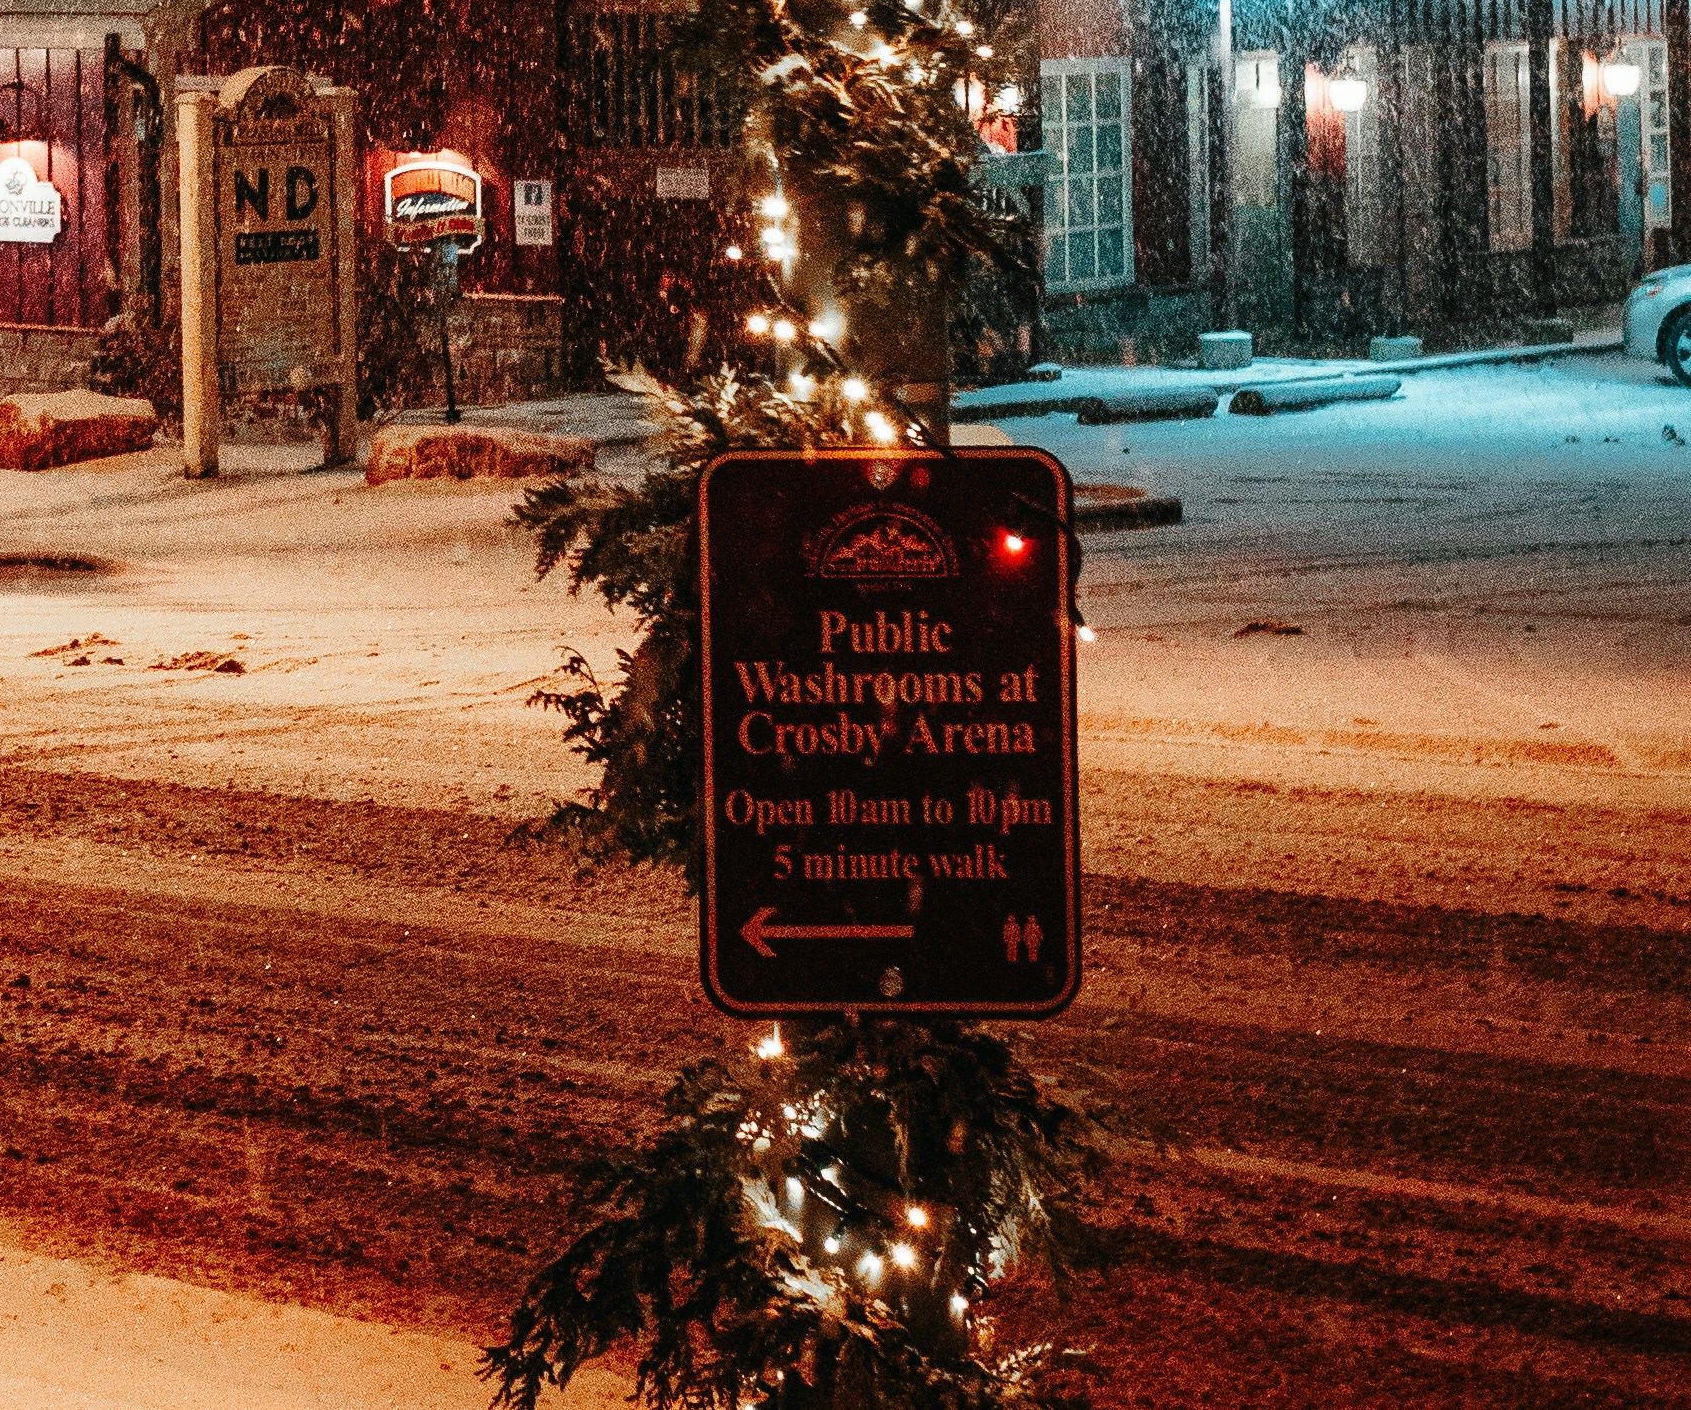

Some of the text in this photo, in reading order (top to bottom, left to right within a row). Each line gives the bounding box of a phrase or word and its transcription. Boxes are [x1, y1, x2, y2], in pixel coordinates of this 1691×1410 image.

[820, 610, 953, 654] Public
[734, 661, 1040, 704] Washrooms at
[737, 710, 1038, 763] Crosby Arena
[723, 788, 1054, 836] Open 10am to 10pm
[774, 844, 1008, 881] 5 minute walk
